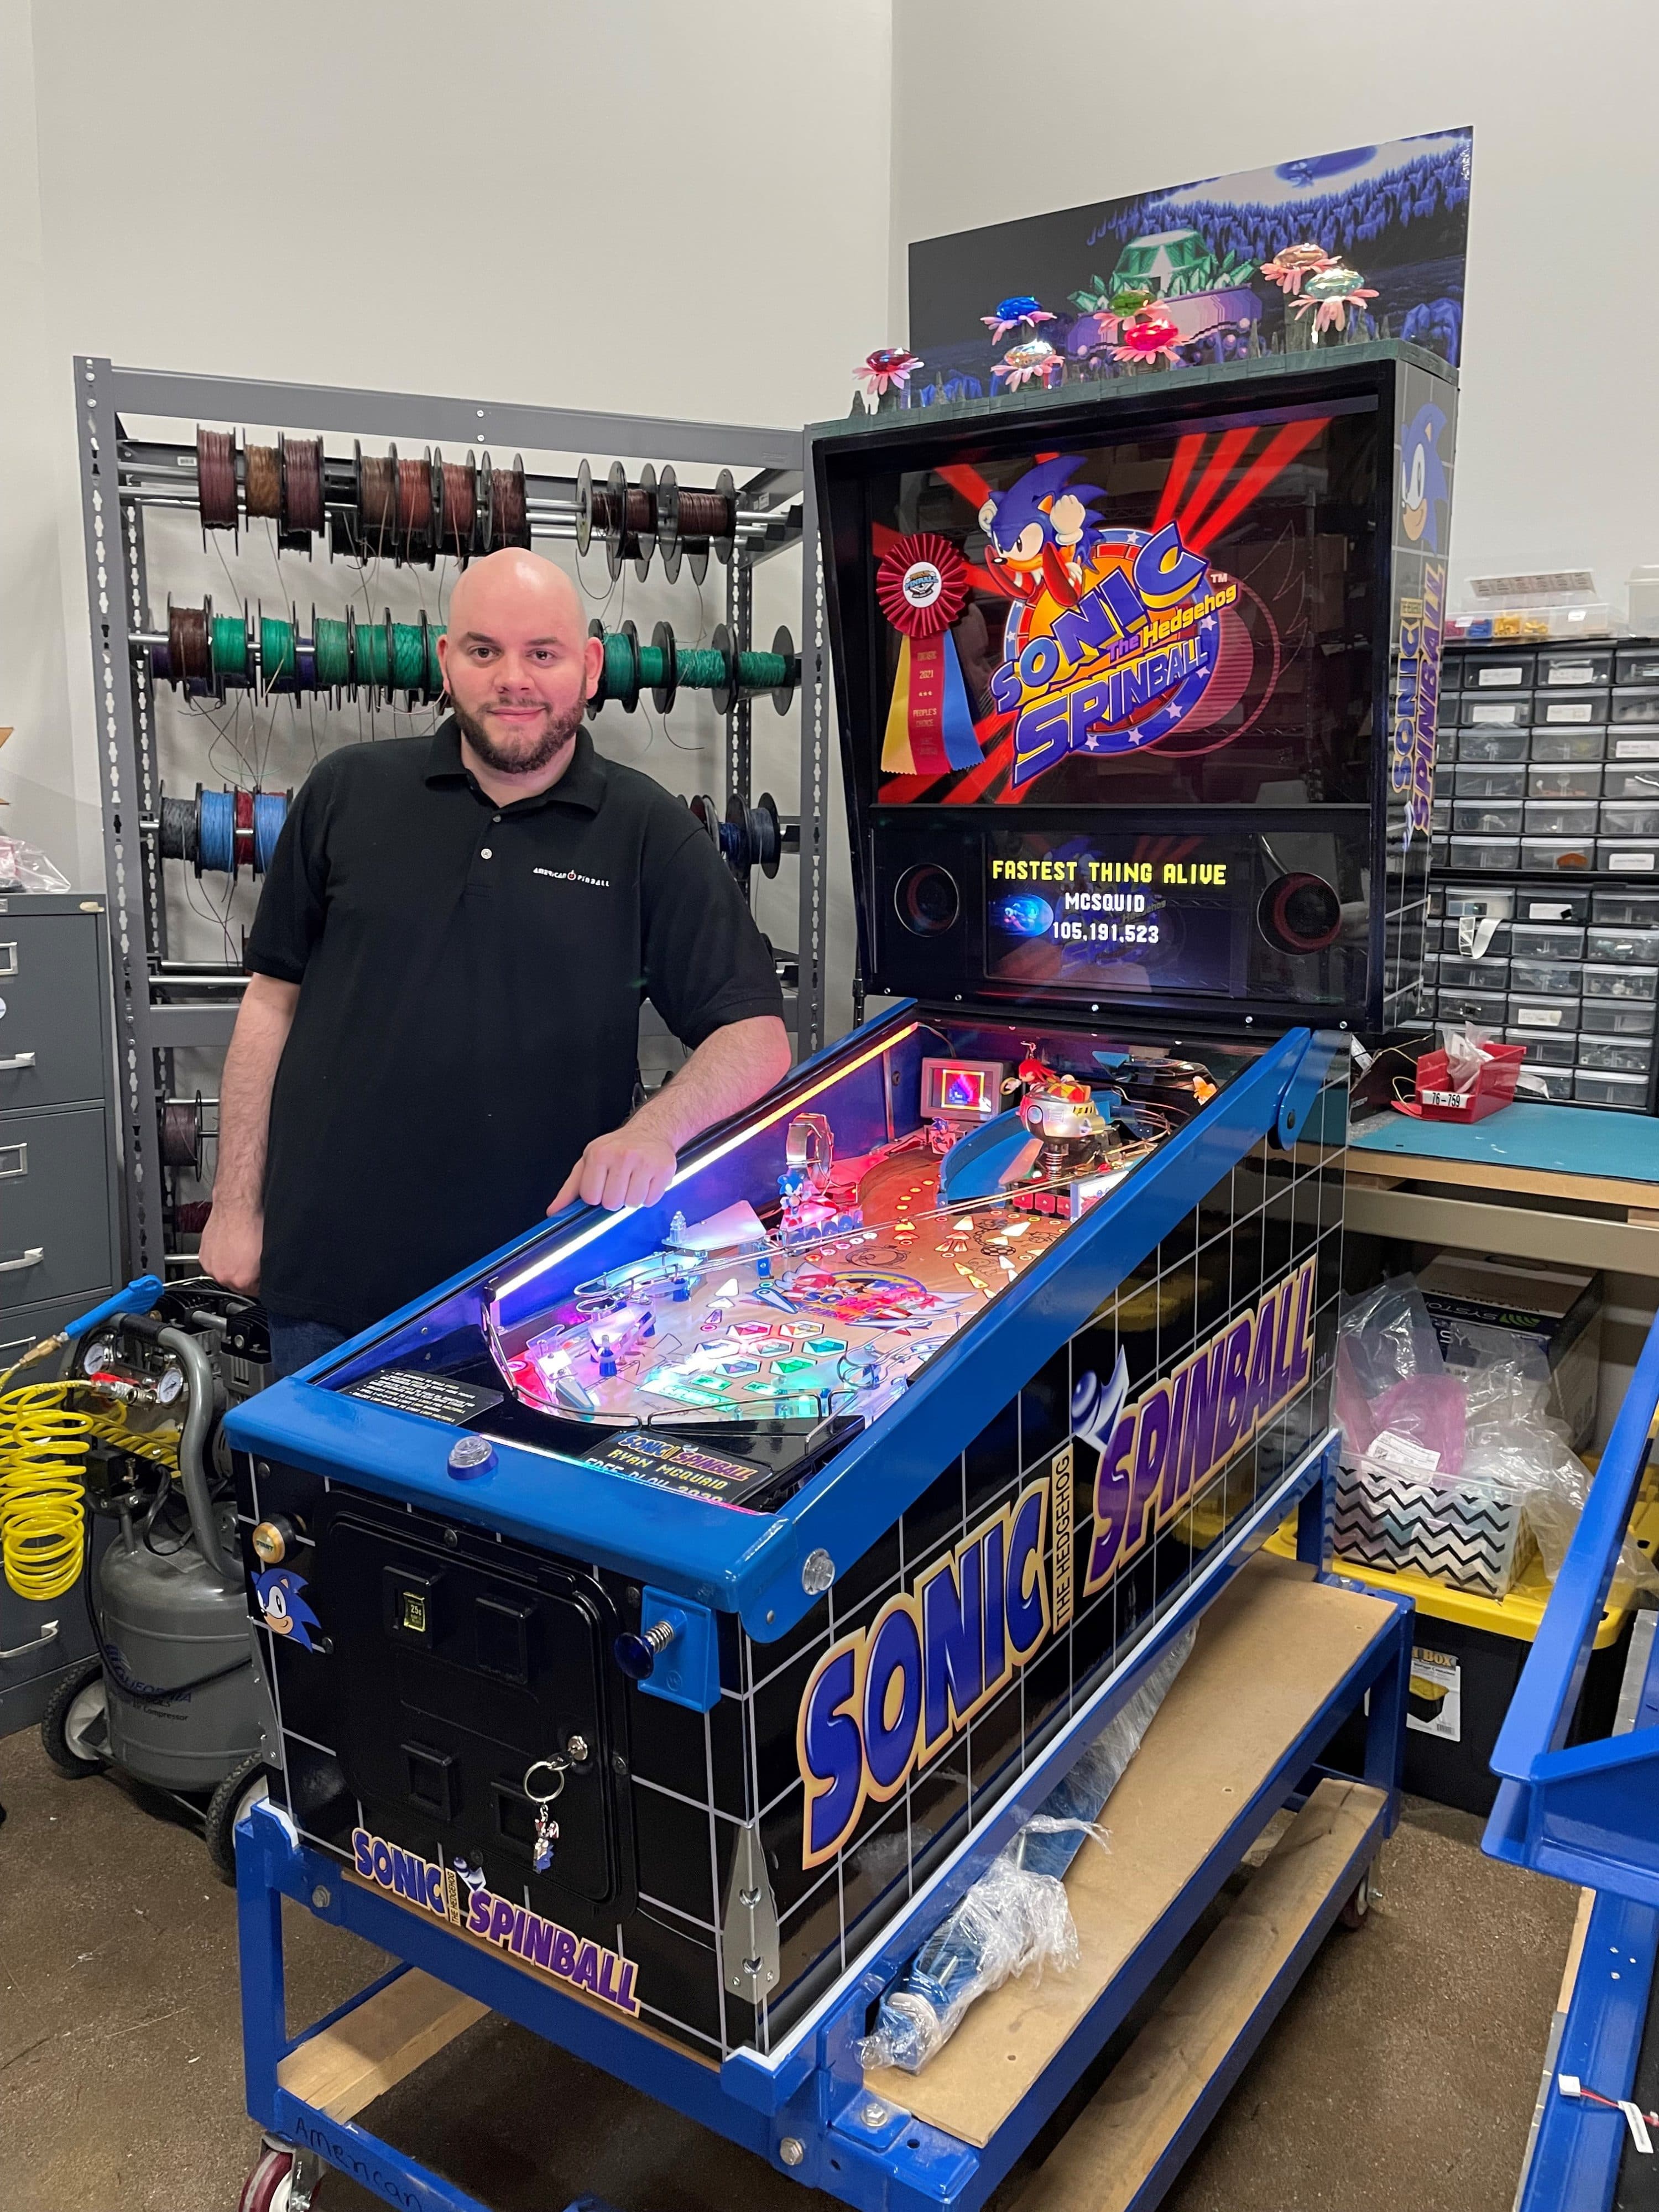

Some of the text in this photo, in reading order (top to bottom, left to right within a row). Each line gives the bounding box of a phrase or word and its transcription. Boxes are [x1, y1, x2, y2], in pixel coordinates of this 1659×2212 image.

[992, 522, 1208, 713] SONIC
[1107, 583, 1237, 661] The Hedgehog
[913, 708, 937, 717] PEOPLE'S
[1013, 636, 1209, 786] SPINBALL
[1393, 619, 1421, 792] SONIC
[1412, 563, 1445, 836] SPINBALL
[533, 867, 567, 879] AMERICAN
[992, 860, 1227, 885] FASTEST THING ALIVE
[1065, 892, 1145, 912] MCSQUID
[1052, 921, 1160, 943] 105,191,523
[608, 1449, 654, 1468] RYAN
[655, 1464, 729, 1490] MCQUAID
[618, 1436, 676, 1458] SONIC
[670, 1451, 758, 1482] SPINBALL
[801, 1258, 1327, 1861] SONIC THE HEDGEHOG SPINBALL TM
[353, 1829, 447, 1917] SONIC
[447, 1871, 458, 1910] HEDGEHOG
[467, 1891, 639, 2015] SPINBALL
